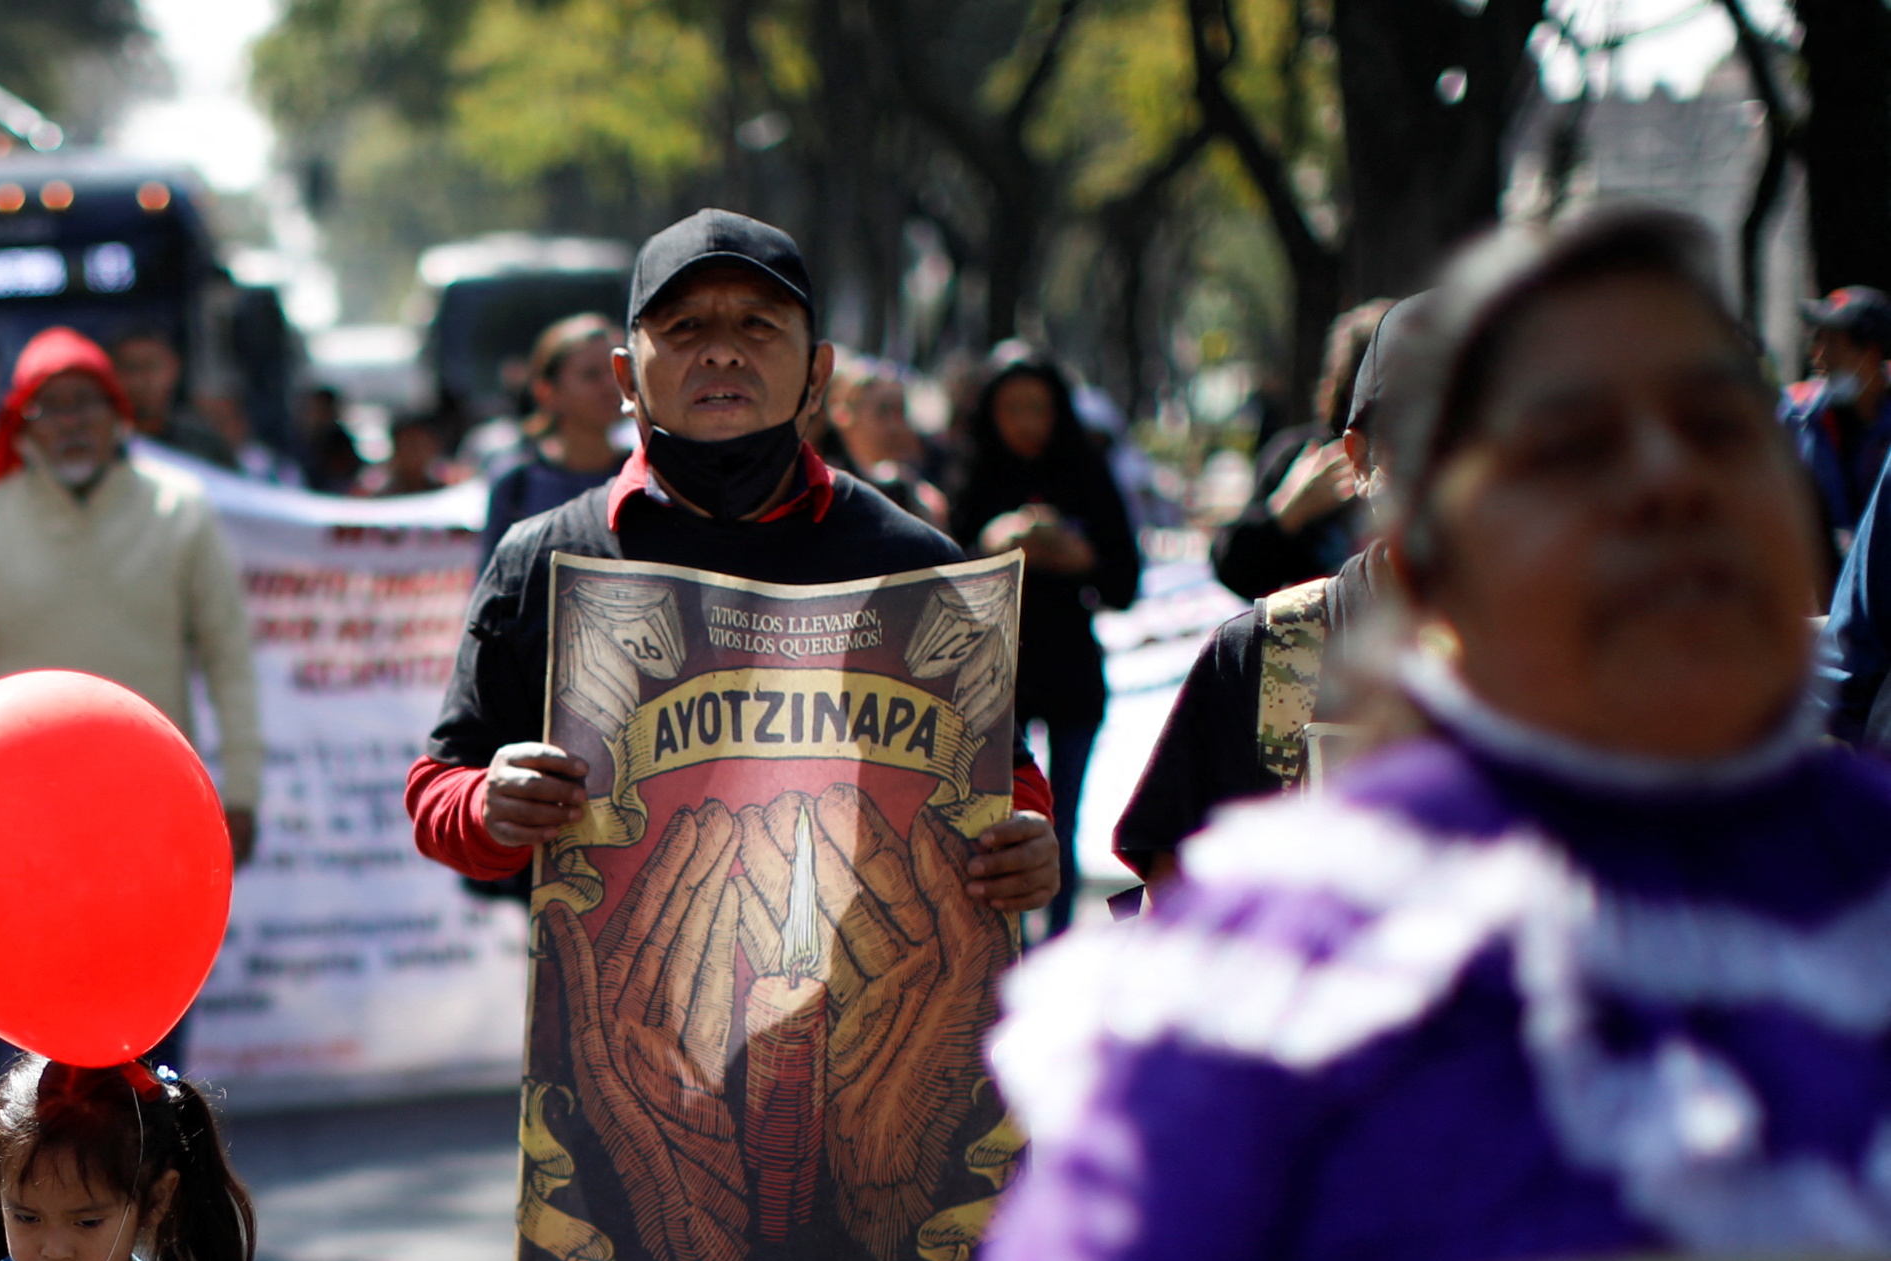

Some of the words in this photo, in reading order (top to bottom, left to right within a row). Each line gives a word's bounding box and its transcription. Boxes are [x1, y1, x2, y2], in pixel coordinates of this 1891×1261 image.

[710, 605, 749, 627] ¡VIVOS
[751, 613, 784, 633] LOS
[787, 609, 881, 634] LLEVARON,
[623, 637, 664, 663] 26
[708, 626, 742, 649] VIVOS
[744, 634, 776, 654] LOS
[779, 628, 883, 660] QUEREMOS!
[653, 690, 942, 763] AYOTZINAPA
